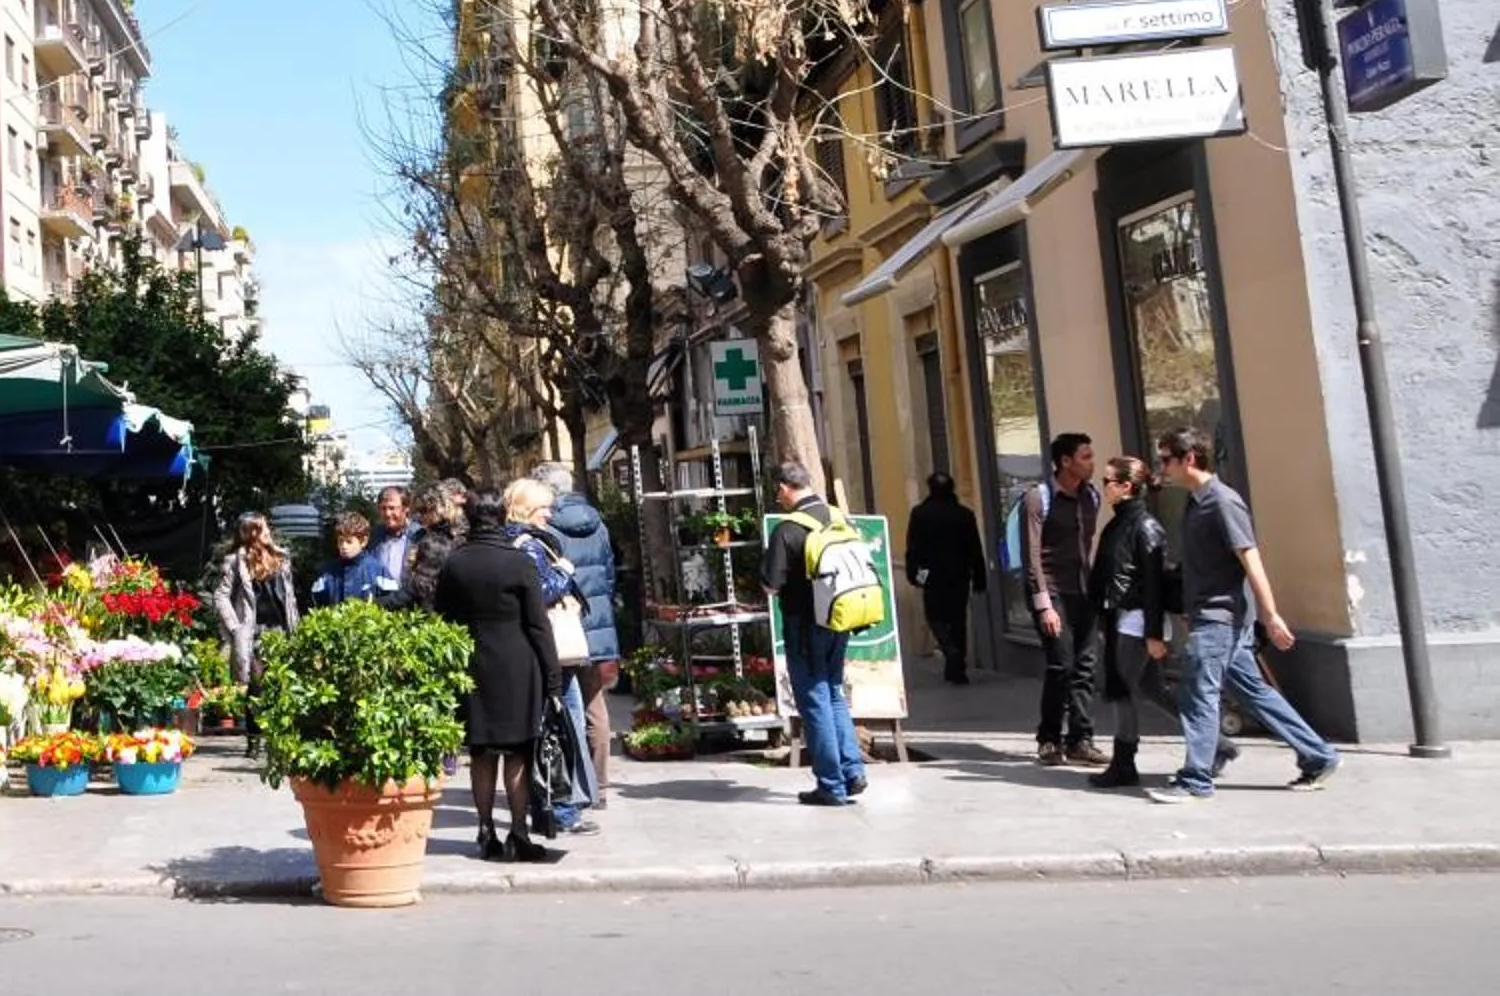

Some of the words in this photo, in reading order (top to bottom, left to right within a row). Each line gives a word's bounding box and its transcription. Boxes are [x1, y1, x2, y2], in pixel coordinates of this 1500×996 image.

[1139, 10, 1214, 28] settimo
[1065, 75, 1229, 106] MARELLA
[717, 395, 761, 406] FARMACIA
